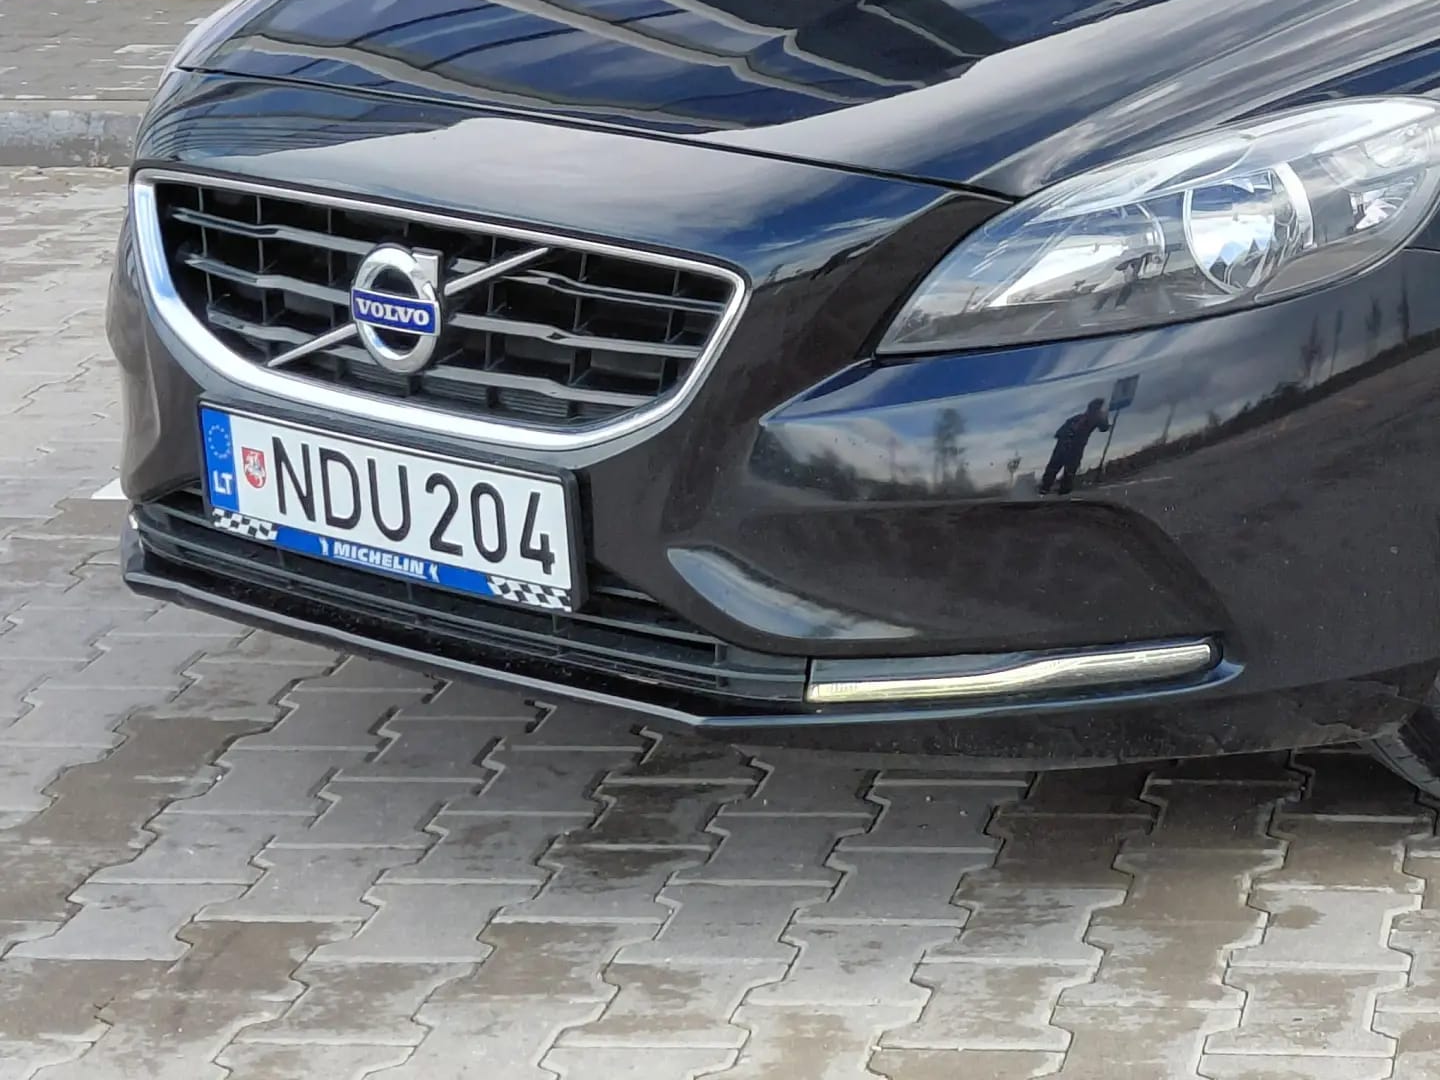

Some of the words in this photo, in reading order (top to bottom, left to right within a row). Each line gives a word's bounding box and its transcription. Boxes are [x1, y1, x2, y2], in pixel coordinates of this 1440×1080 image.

[355, 297, 431, 326] VOLVO
[213, 469, 234, 497] LT
[333, 540, 425, 577] MICHELIN
